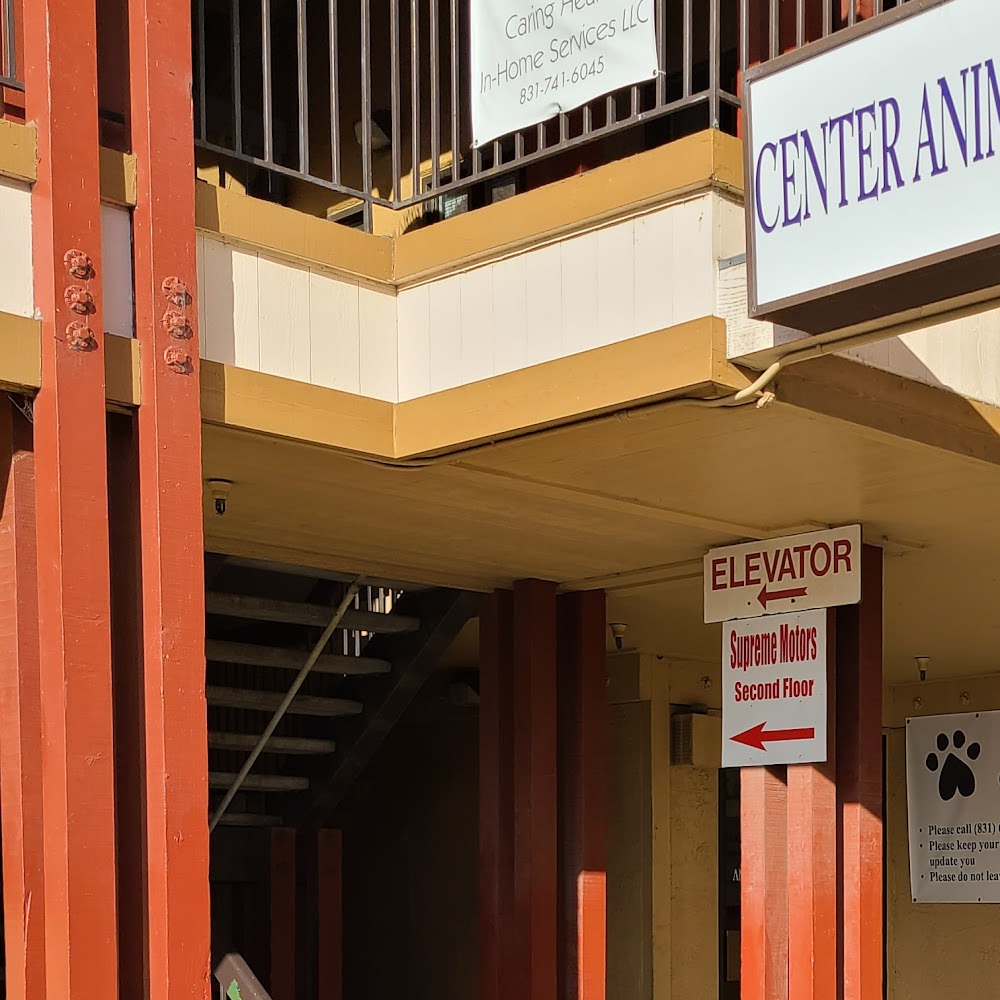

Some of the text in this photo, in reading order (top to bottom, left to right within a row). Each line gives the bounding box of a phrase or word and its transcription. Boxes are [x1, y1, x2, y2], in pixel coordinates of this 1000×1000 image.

[505, 3, 555, 40] Caring
[480, 0, 650, 94] In-Home Services LLC
[519, 55, 605, 105] 831-741-6045
[756, 97, 905, 234] CENTER
[711, 539, 852, 591] ELEVATOR
[730, 624, 817, 671] Supreme Motors
[735, 677, 814, 702] Second Floor
[928, 825, 955, 836] Please
[956, 823, 972, 834] call
[974, 822, 996, 836] (831)
[929, 840, 955, 851] Please
[956, 840, 977, 852] keep
[979, 841, 1000, 852] your
[929, 856, 975, 869] update you
[930, 871, 956, 882] Please
[958, 871, 968, 881] do
[970, 871, 984, 881] not
